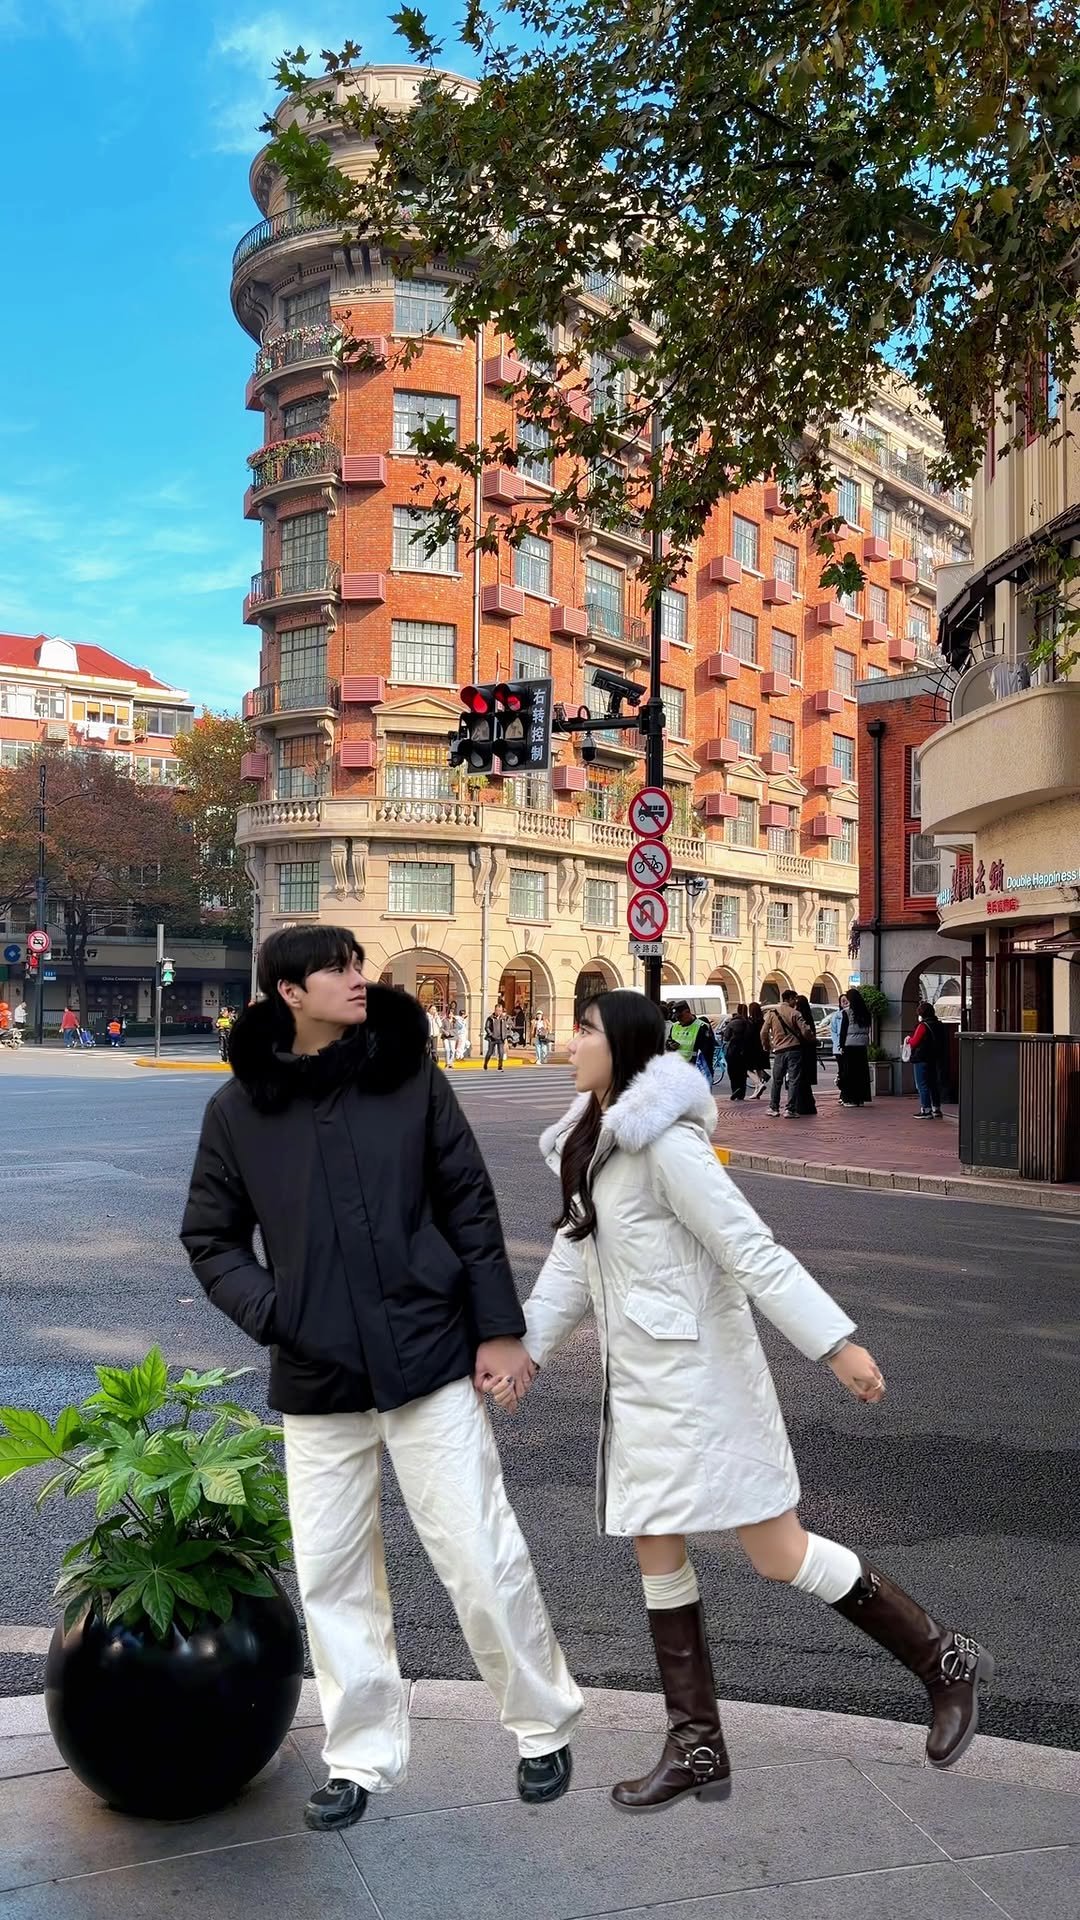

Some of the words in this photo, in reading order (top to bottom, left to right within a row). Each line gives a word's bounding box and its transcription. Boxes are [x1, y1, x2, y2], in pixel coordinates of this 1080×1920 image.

[530, 688, 546, 761] 右转控制
[1006, 874, 1031, 889] Double
[1032, 870, 1077, 886] Happiness
[634, 944, 659, 954] 全路段
